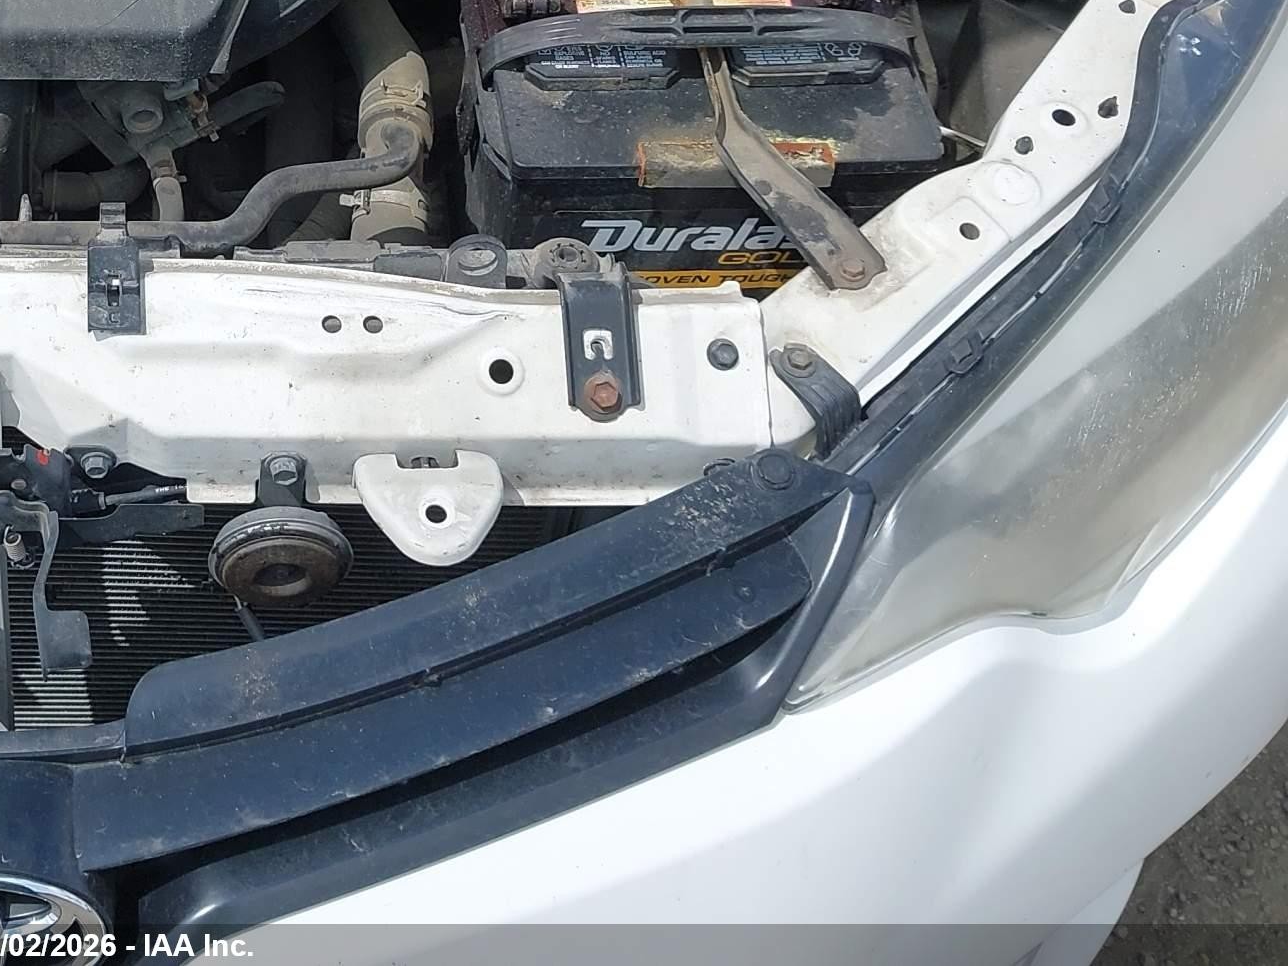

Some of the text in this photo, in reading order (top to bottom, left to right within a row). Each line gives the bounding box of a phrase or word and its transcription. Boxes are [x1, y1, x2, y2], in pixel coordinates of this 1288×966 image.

[581, 218, 798, 252] Durala
[718, 251, 808, 265] GOL
[640, 275, 710, 284] OVEN
